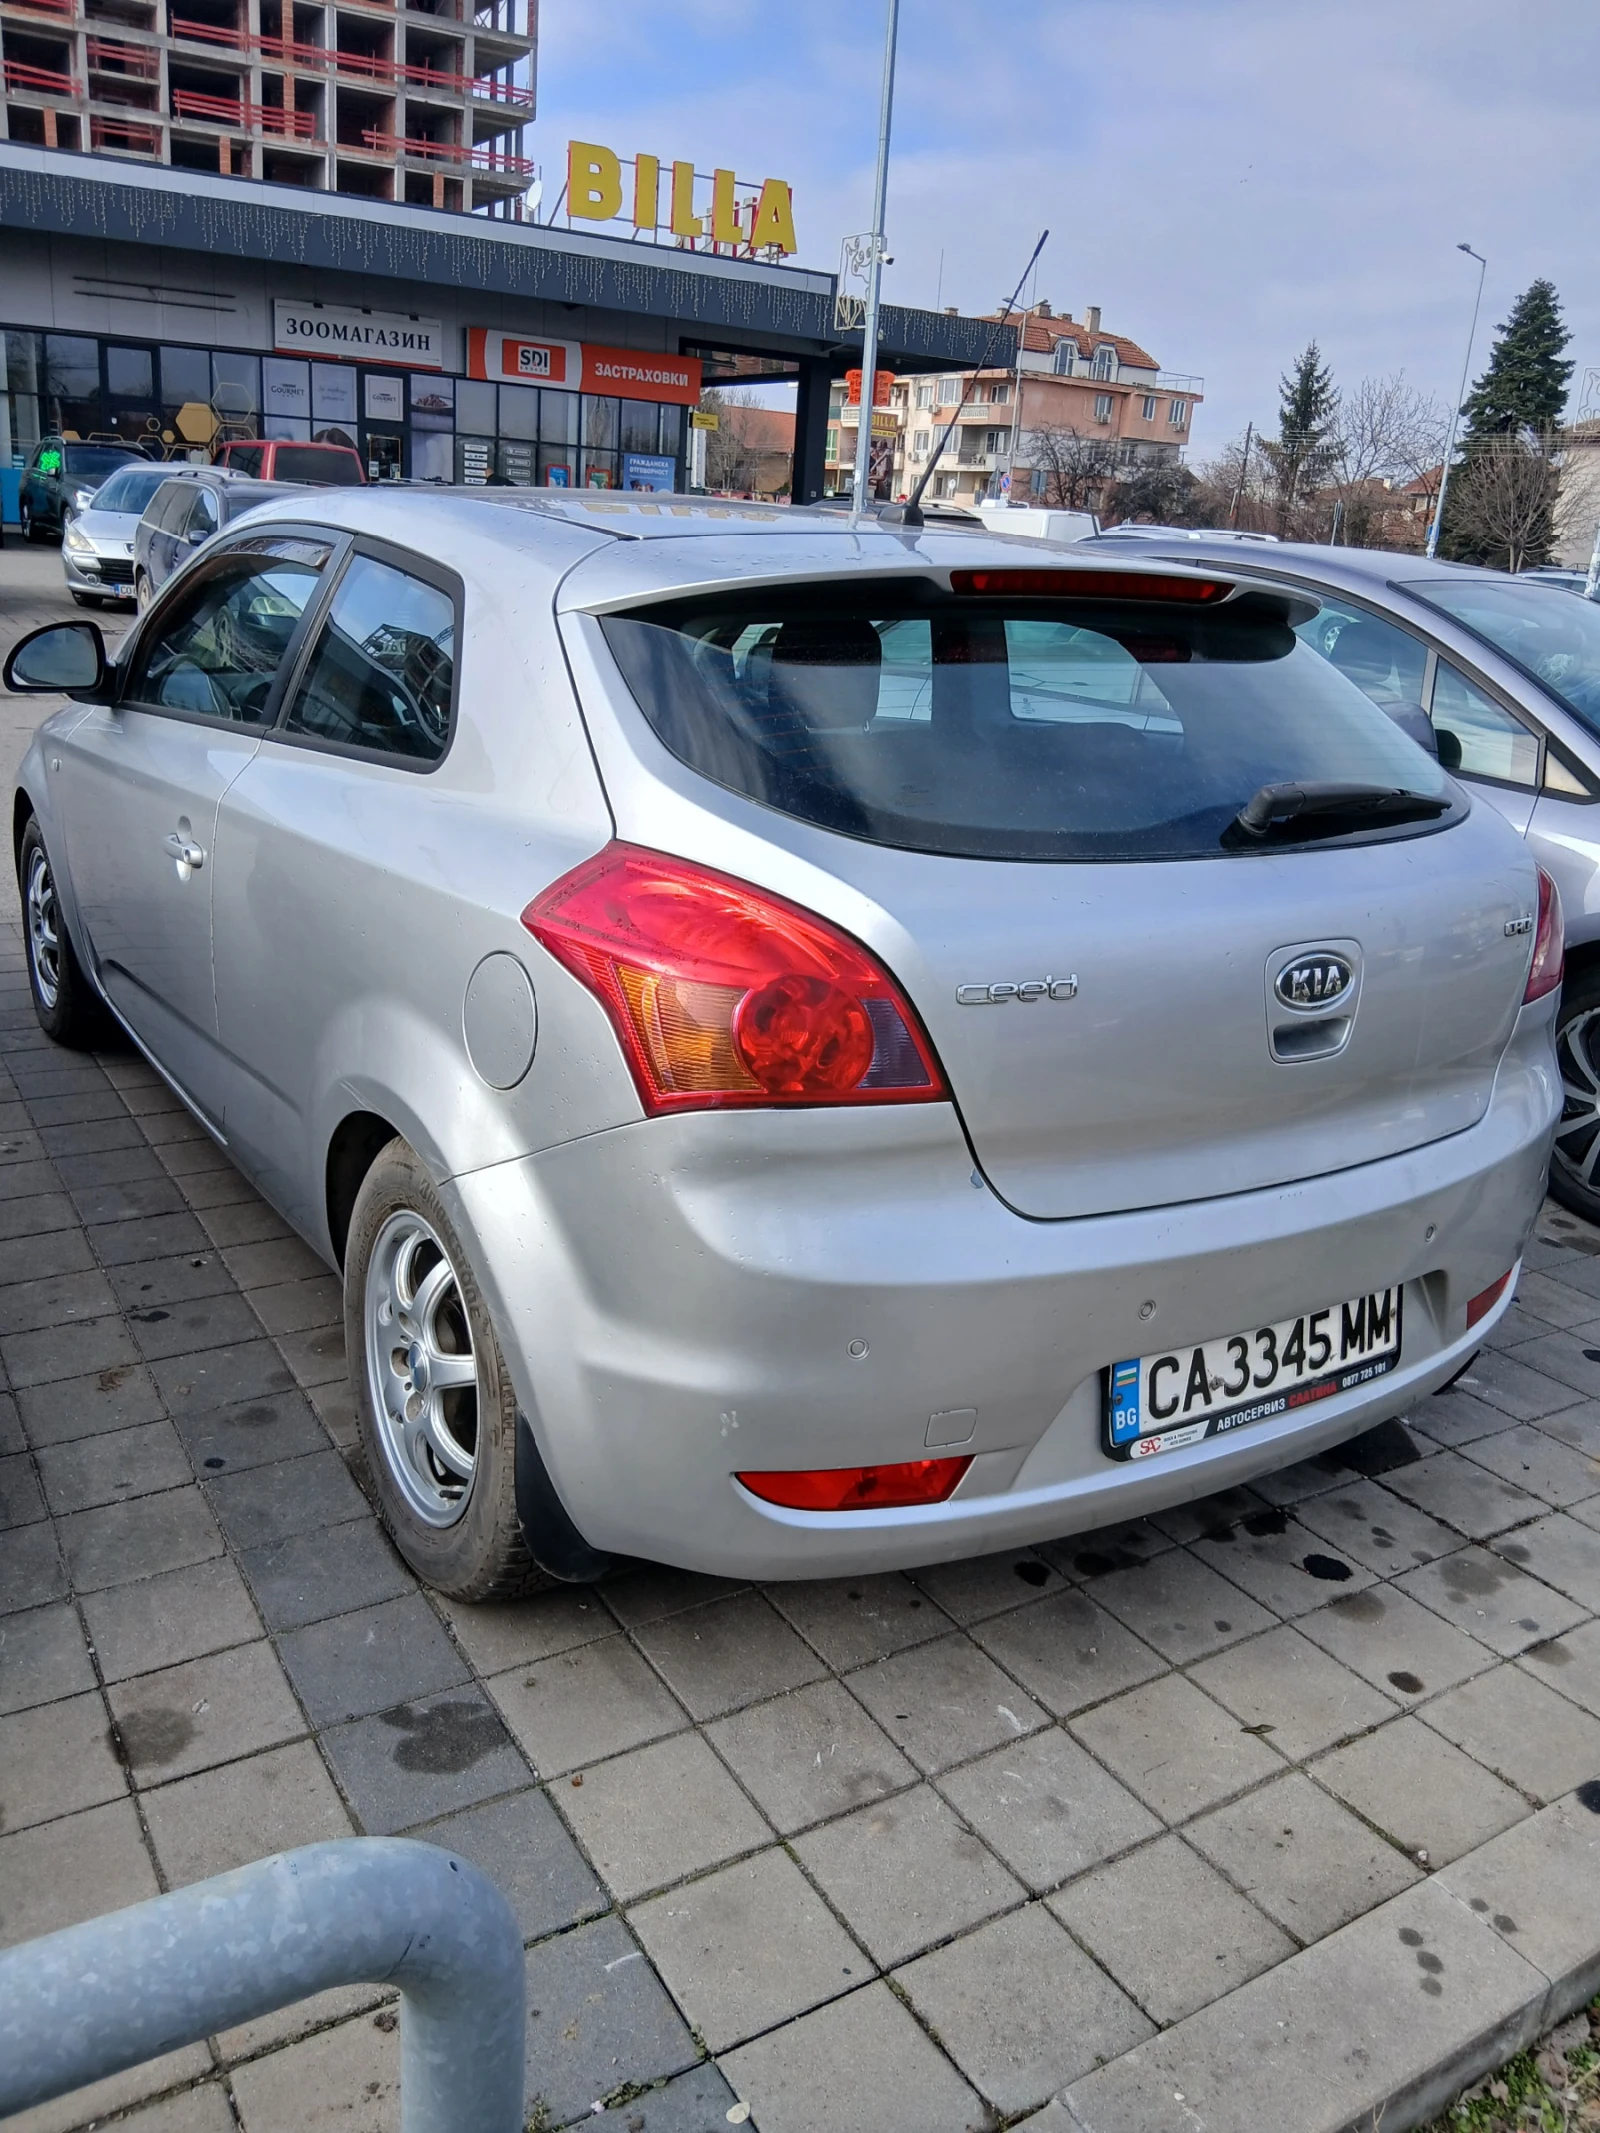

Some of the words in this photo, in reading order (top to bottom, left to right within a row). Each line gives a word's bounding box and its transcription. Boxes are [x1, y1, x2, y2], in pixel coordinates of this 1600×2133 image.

[566, 140, 798, 254] BILLA
[286, 318, 431, 350] ЗООМАГАЗИН
[520, 349, 548, 368] SDI
[595, 362, 688, 387] ЗАСТРАХОВКИ
[271, 385, 304, 396] GOURMET
[629, 458, 668, 468] ГРАЖДАНСКА
[629, 466, 668, 476] ОТГОВОРНОСТ
[1291, 965, 1342, 998] KIA
[1216, 1397, 1286, 1432] АВТОСЕРВИЗ
[1360, 1368, 1373, 1381] 725
[1115, 1408, 1137, 1429] BG
